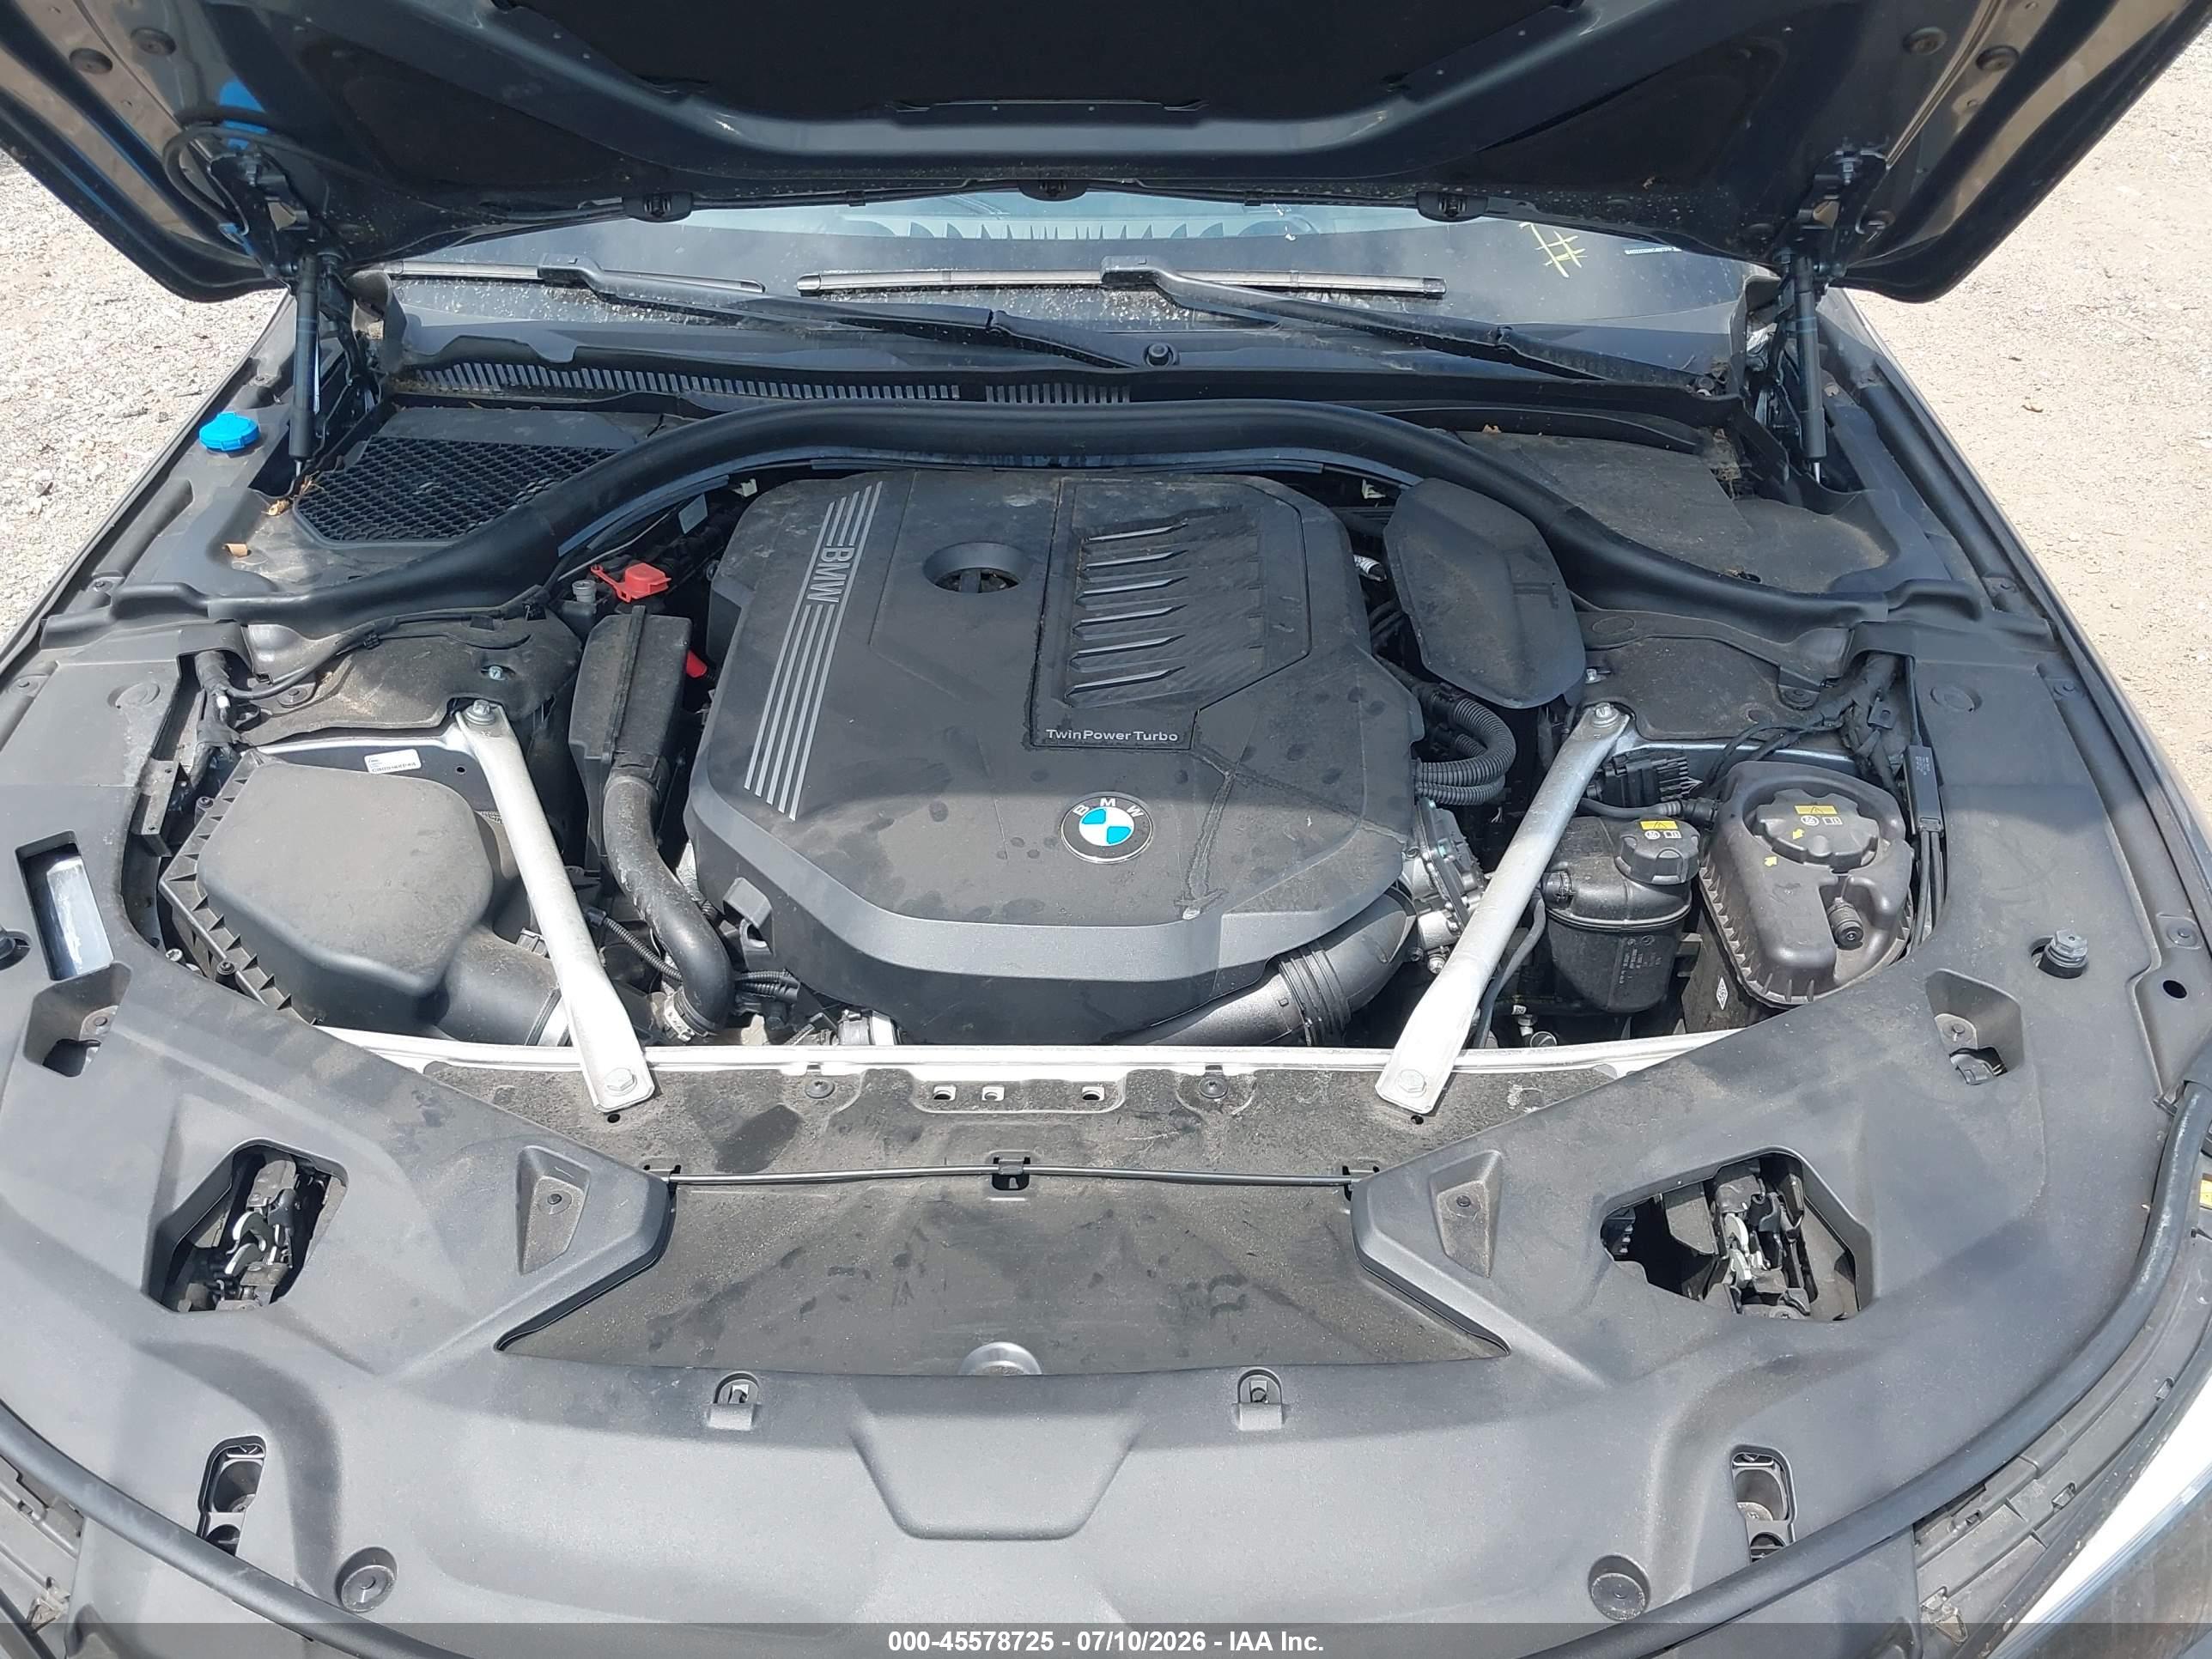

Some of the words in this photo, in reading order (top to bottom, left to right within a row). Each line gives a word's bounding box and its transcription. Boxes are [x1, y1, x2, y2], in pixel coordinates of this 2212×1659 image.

[807, 547, 855, 603] BMW
[1133, 731, 1178, 741] Turbo
[1073, 798, 1145, 817] BMW
